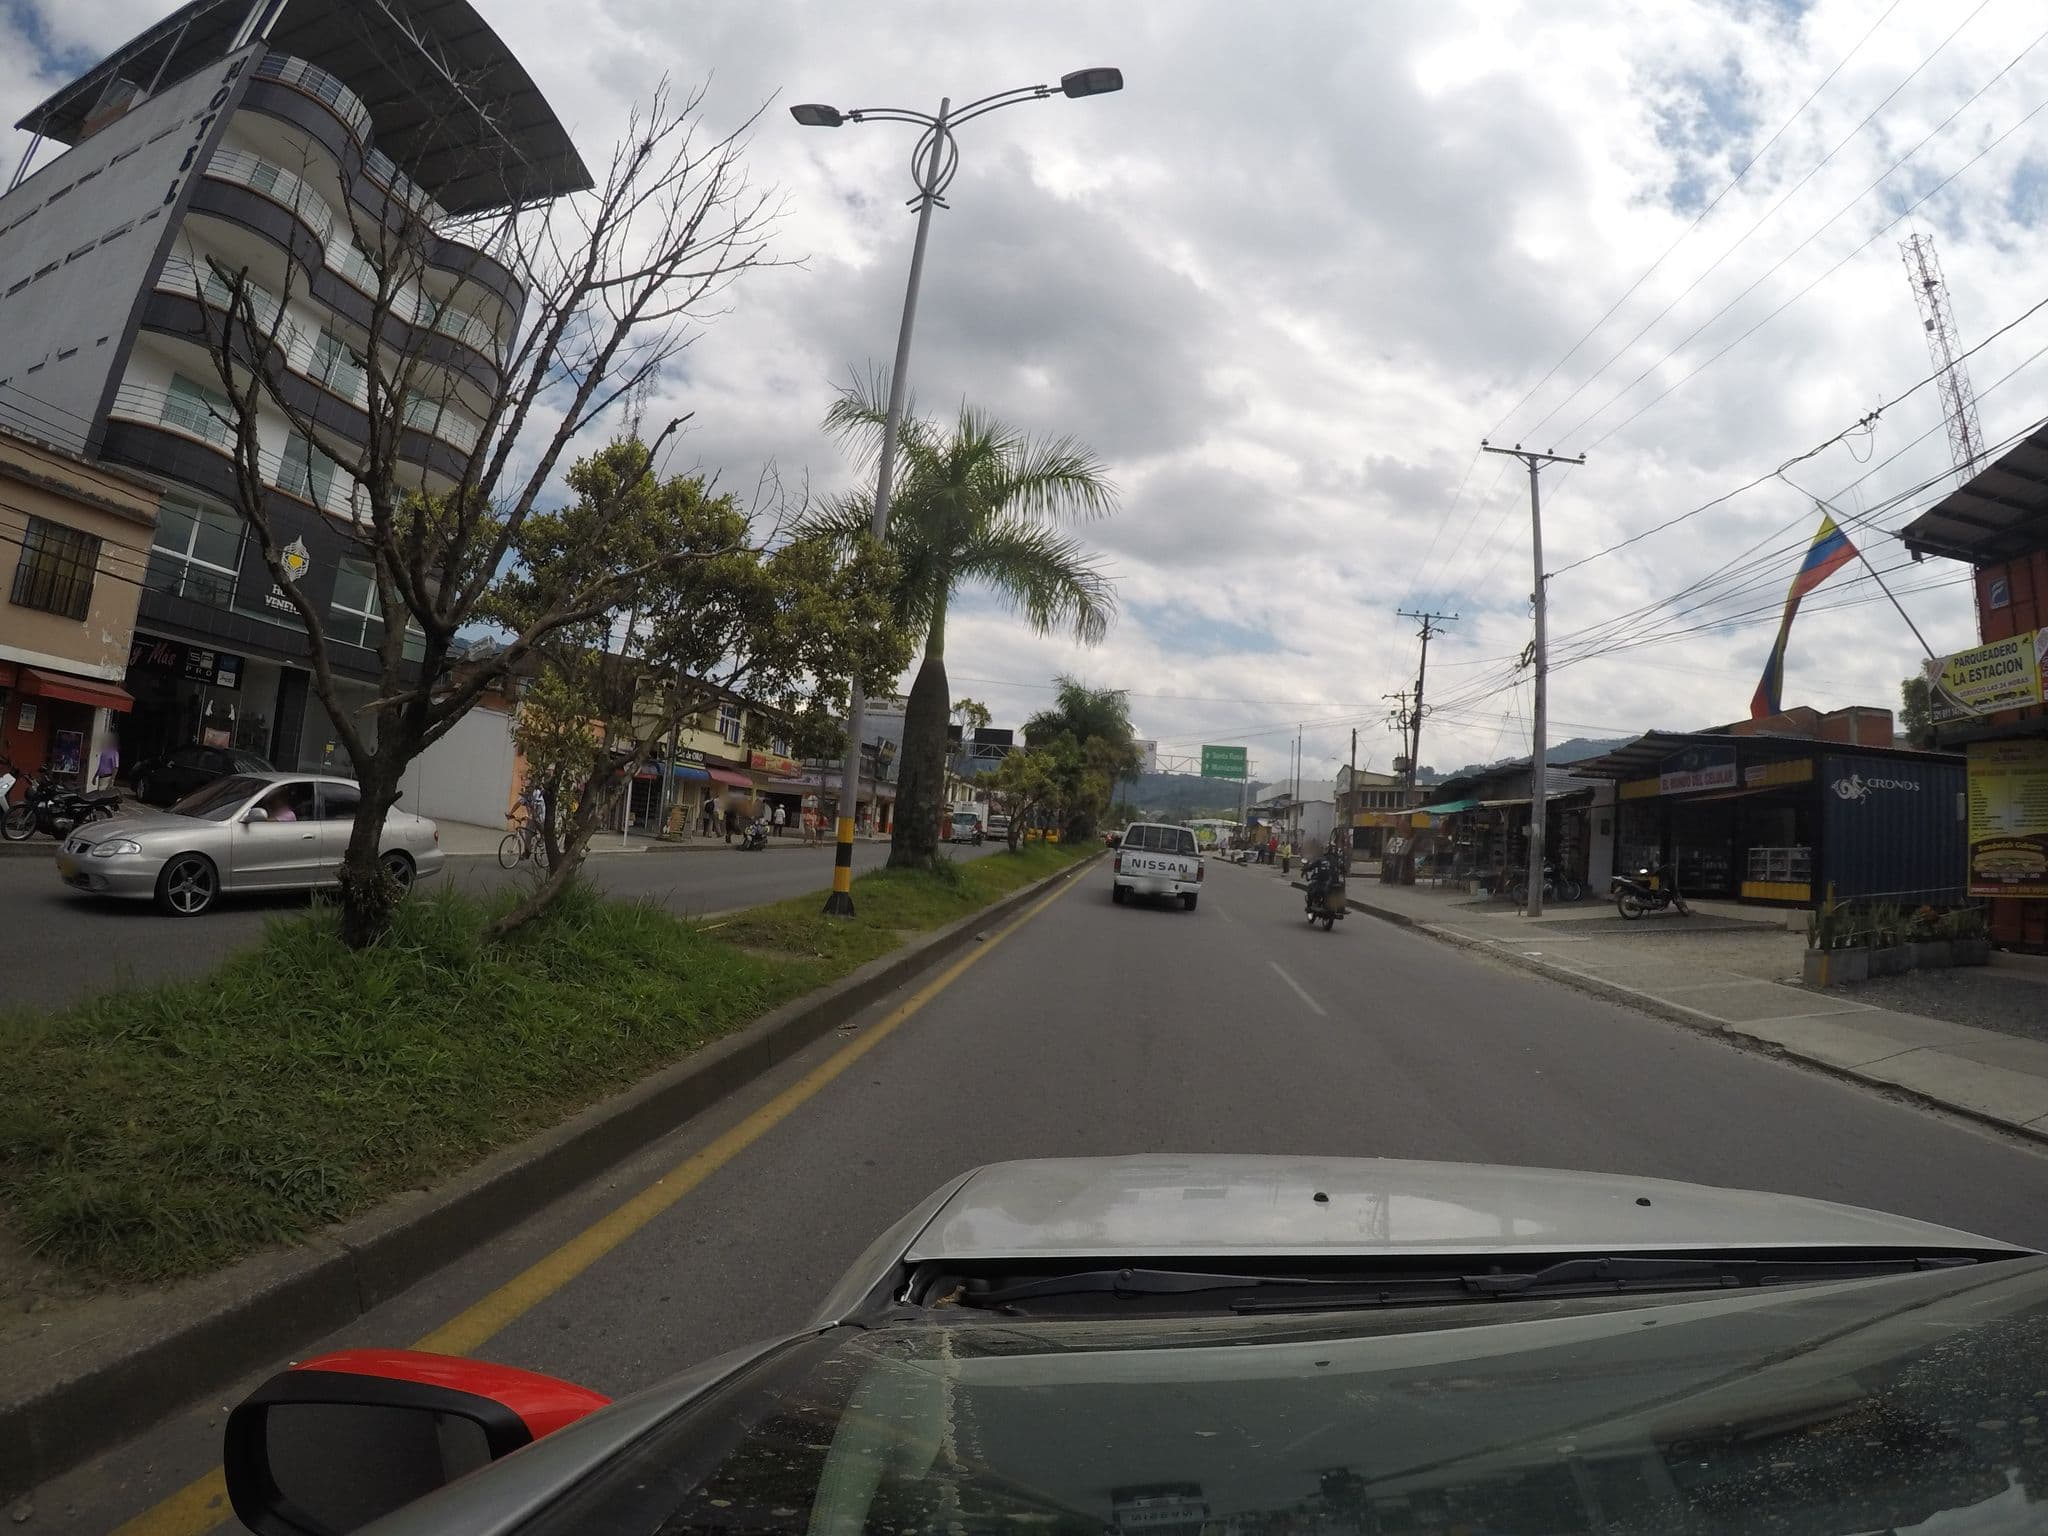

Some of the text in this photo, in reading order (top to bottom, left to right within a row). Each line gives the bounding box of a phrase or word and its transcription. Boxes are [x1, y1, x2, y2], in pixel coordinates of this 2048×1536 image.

[163, 55, 249, 206] HOTEL
[1953, 642, 2018, 669] PARQUEADERO
[185, 664, 213, 677] PRO
[1952, 671, 1966, 686] LA
[1968, 656, 2023, 682] ESTACION
[1987, 683, 1999, 692] LAS
[1999, 682, 2007, 690] 24
[1867, 778, 1920, 791] CRONOS
[1131, 858, 1188, 873] NISSAN
